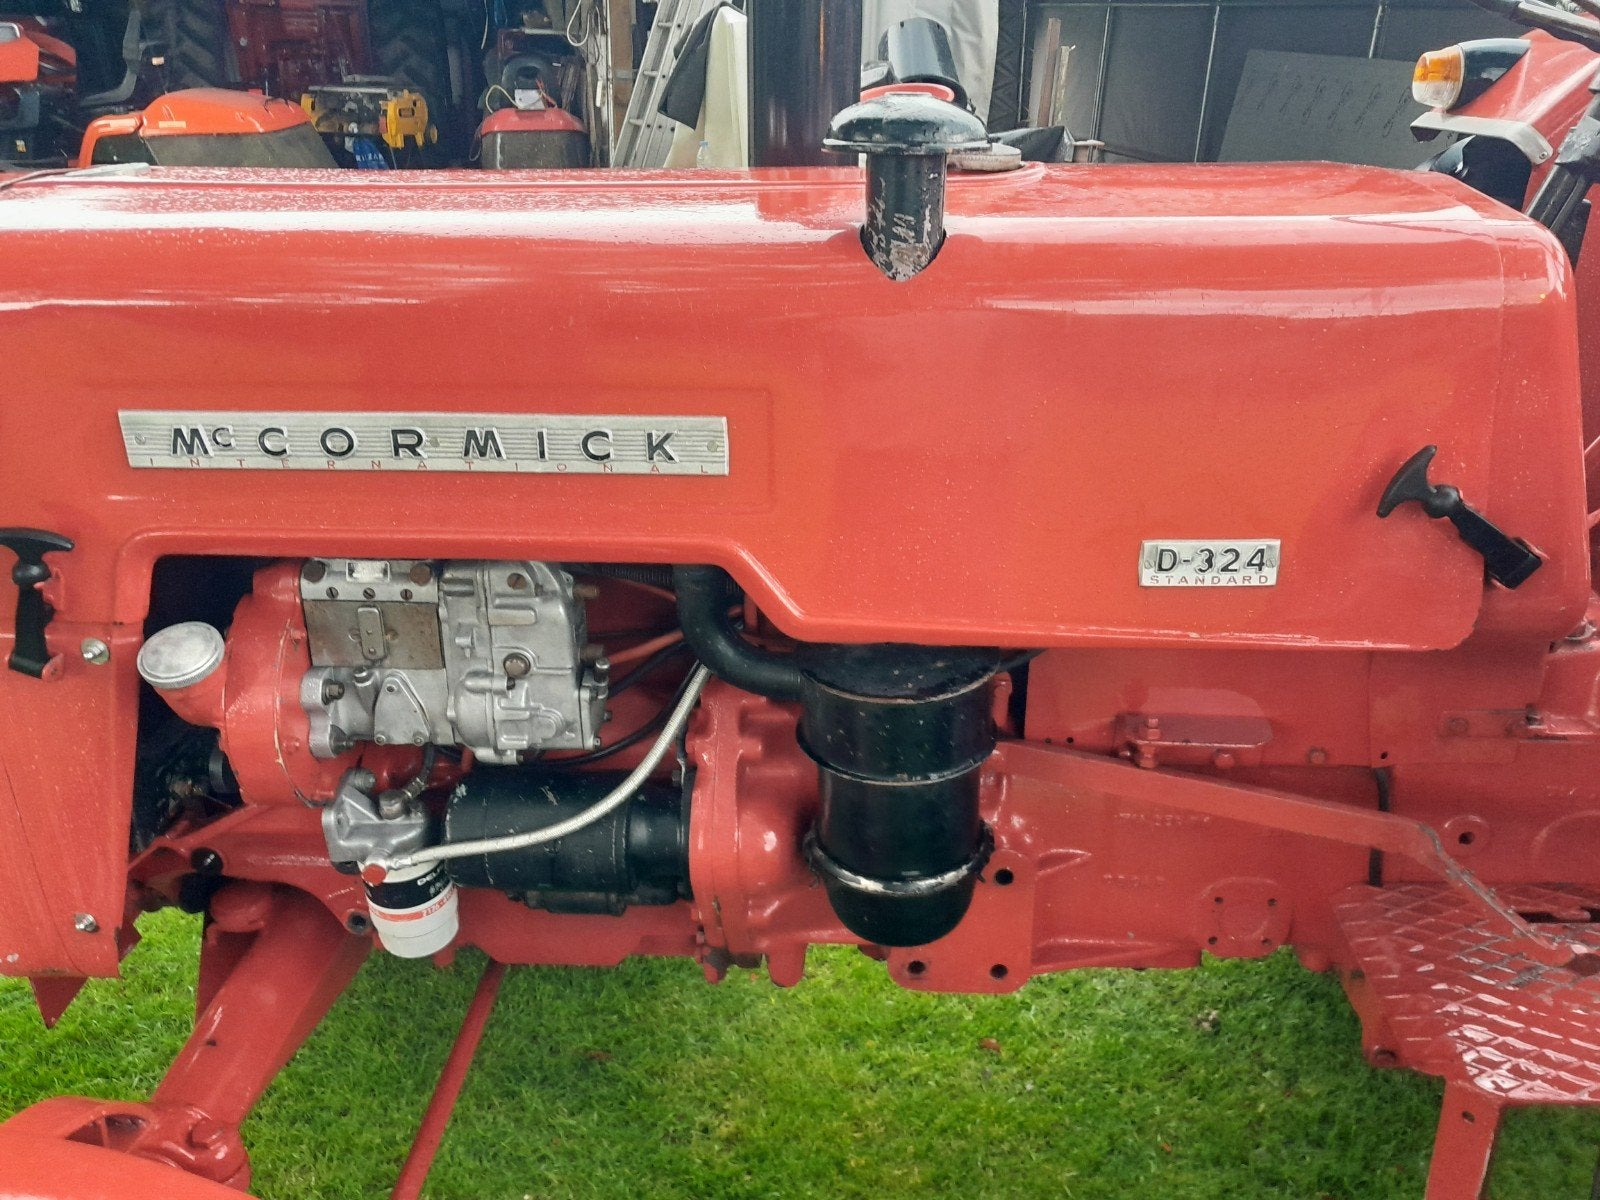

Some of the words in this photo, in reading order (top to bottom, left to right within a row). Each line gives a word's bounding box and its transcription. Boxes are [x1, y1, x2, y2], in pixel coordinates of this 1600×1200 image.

[149, 457, 708, 474] INTERNATIONAL
[1156, 547, 1266, 573] D-324
[1150, 575, 1269, 585] STANDARD
